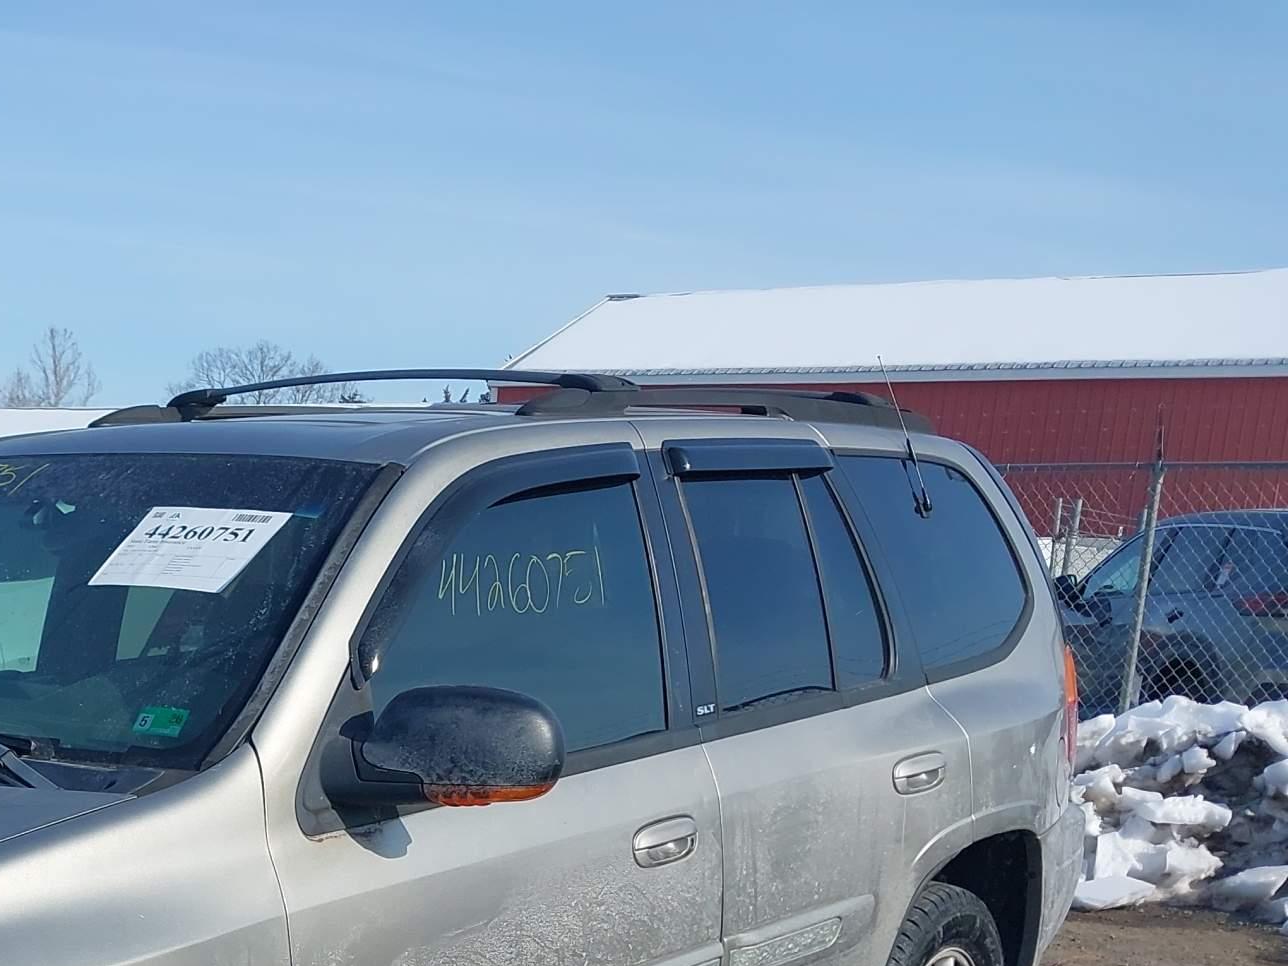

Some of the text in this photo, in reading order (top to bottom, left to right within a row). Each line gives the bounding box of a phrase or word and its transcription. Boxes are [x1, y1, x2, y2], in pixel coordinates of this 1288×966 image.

[143, 523, 258, 544] 44260751
[438, 545, 606, 617] 44260751
[696, 703, 716, 716] SLT
[138, 715, 150, 728] 5
